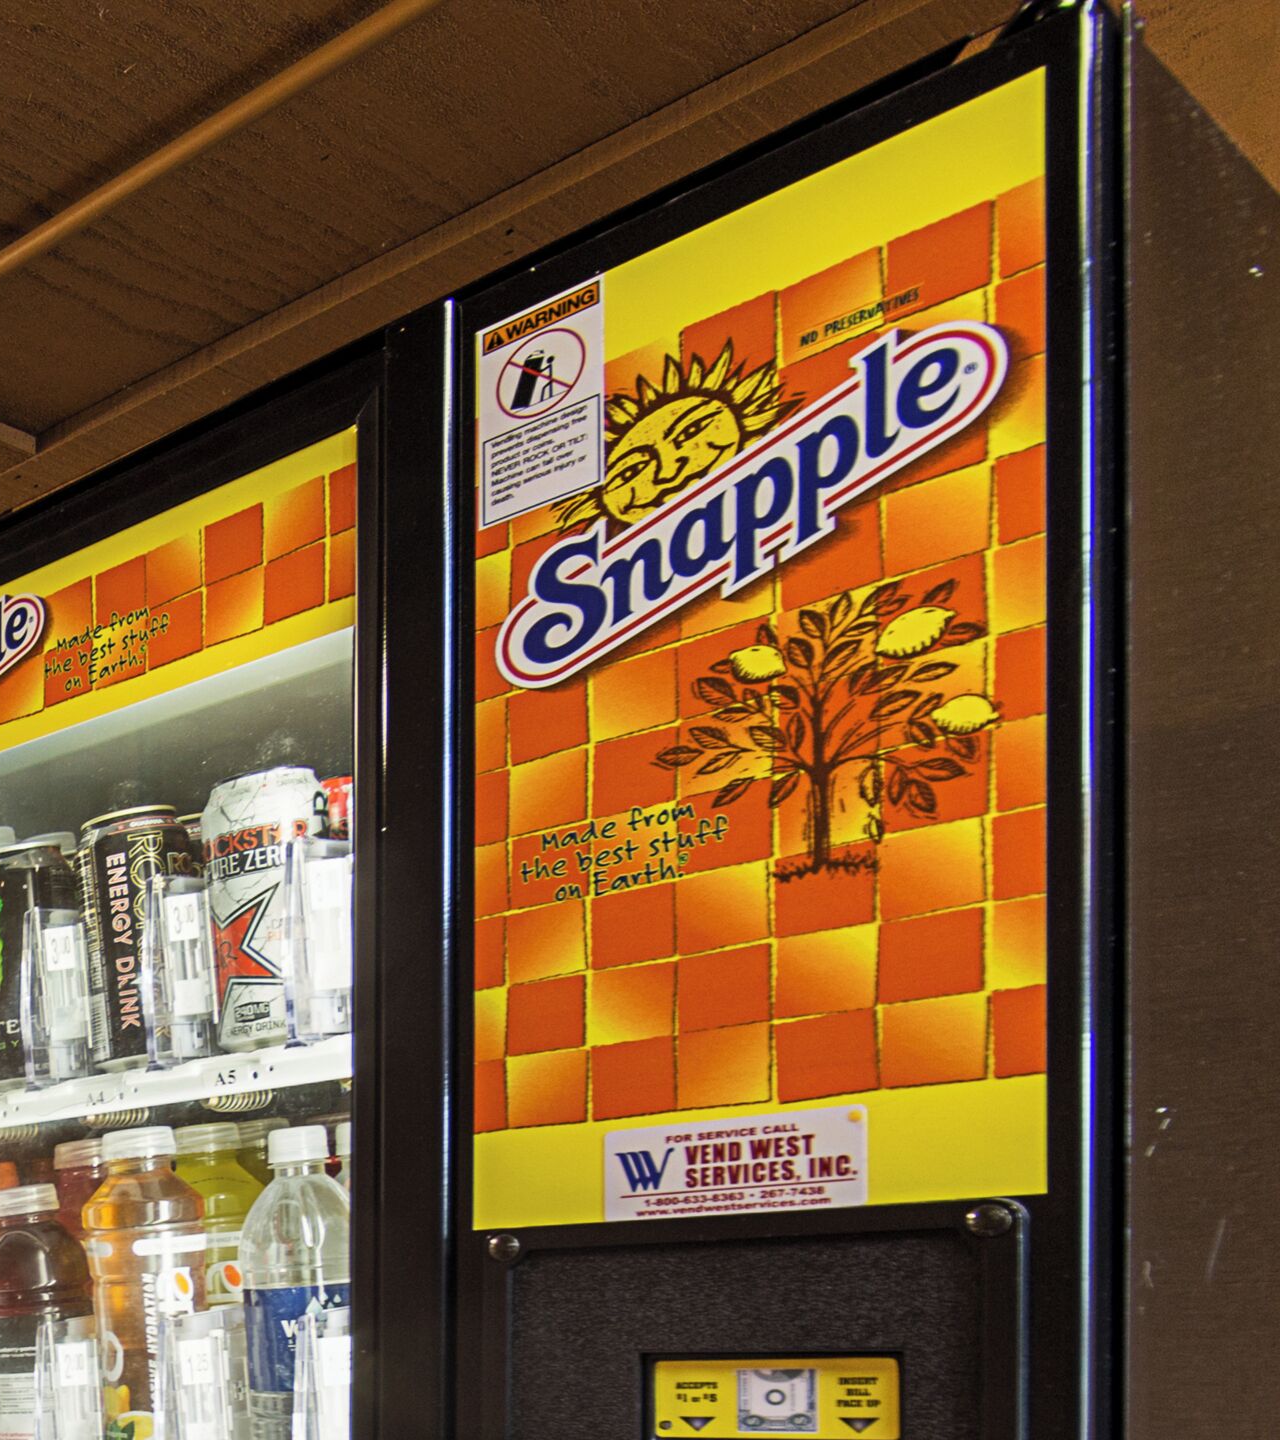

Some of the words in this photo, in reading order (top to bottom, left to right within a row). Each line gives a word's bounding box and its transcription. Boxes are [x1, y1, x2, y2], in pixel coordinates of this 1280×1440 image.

[505, 288, 595, 341] WARNING
[800, 329, 818, 347] NO
[824, 287, 920, 338] PRESERVATIVES
[490, 432, 523, 448] Vending
[524, 418, 558, 435] machine
[560, 405, 588, 420] design
[490, 441, 524, 460] prevents
[526, 423, 570, 444] dispensing
[571, 415, 588, 426] free
[490, 452, 521, 469] product
[522, 448, 530, 456] or
[490, 460, 521, 478] NEVER
[523, 450, 550, 464] ROCK
[552, 442, 566, 453] OR
[490, 470, 524, 487] Machine
[526, 464, 540, 474] can
[556, 450, 574, 461] over
[490, 481, 522, 497] causing
[523, 469, 552, 484] serious
[554, 459, 576, 472] injury
[578, 454, 587, 463] or
[522, 333, 961, 665] Snapple
[44, 658, 72, 678] the
[78, 637, 116, 666] best
[122, 613, 169, 650] stuff
[57, 626, 102, 651] Made
[109, 607, 149, 632] from
[65, 677, 82, 691] on
[541, 820, 617, 851] Made
[628, 803, 695, 831] from
[521, 858, 567, 883] the
[576, 840, 639, 872] best
[650, 816, 728, 857] stuff
[106, 851, 134, 946] ENERGY
[555, 883, 582, 901] on
[115, 956, 141, 1030] DRINK
[215, 1069, 237, 1087] A5
[665, 1133, 693, 1144] FOR
[697, 1127, 757, 1141] SERVICE
[762, 1123, 799, 1134] CALL
[685, 1141, 742, 1166] VEND
[749, 1134, 815, 1160] WEST
[809, 1155, 858, 1179] INC.
[635, 1197, 832, 1218] www.vendwestservices.com
[142, 1273, 159, 1354] HYDRATION
